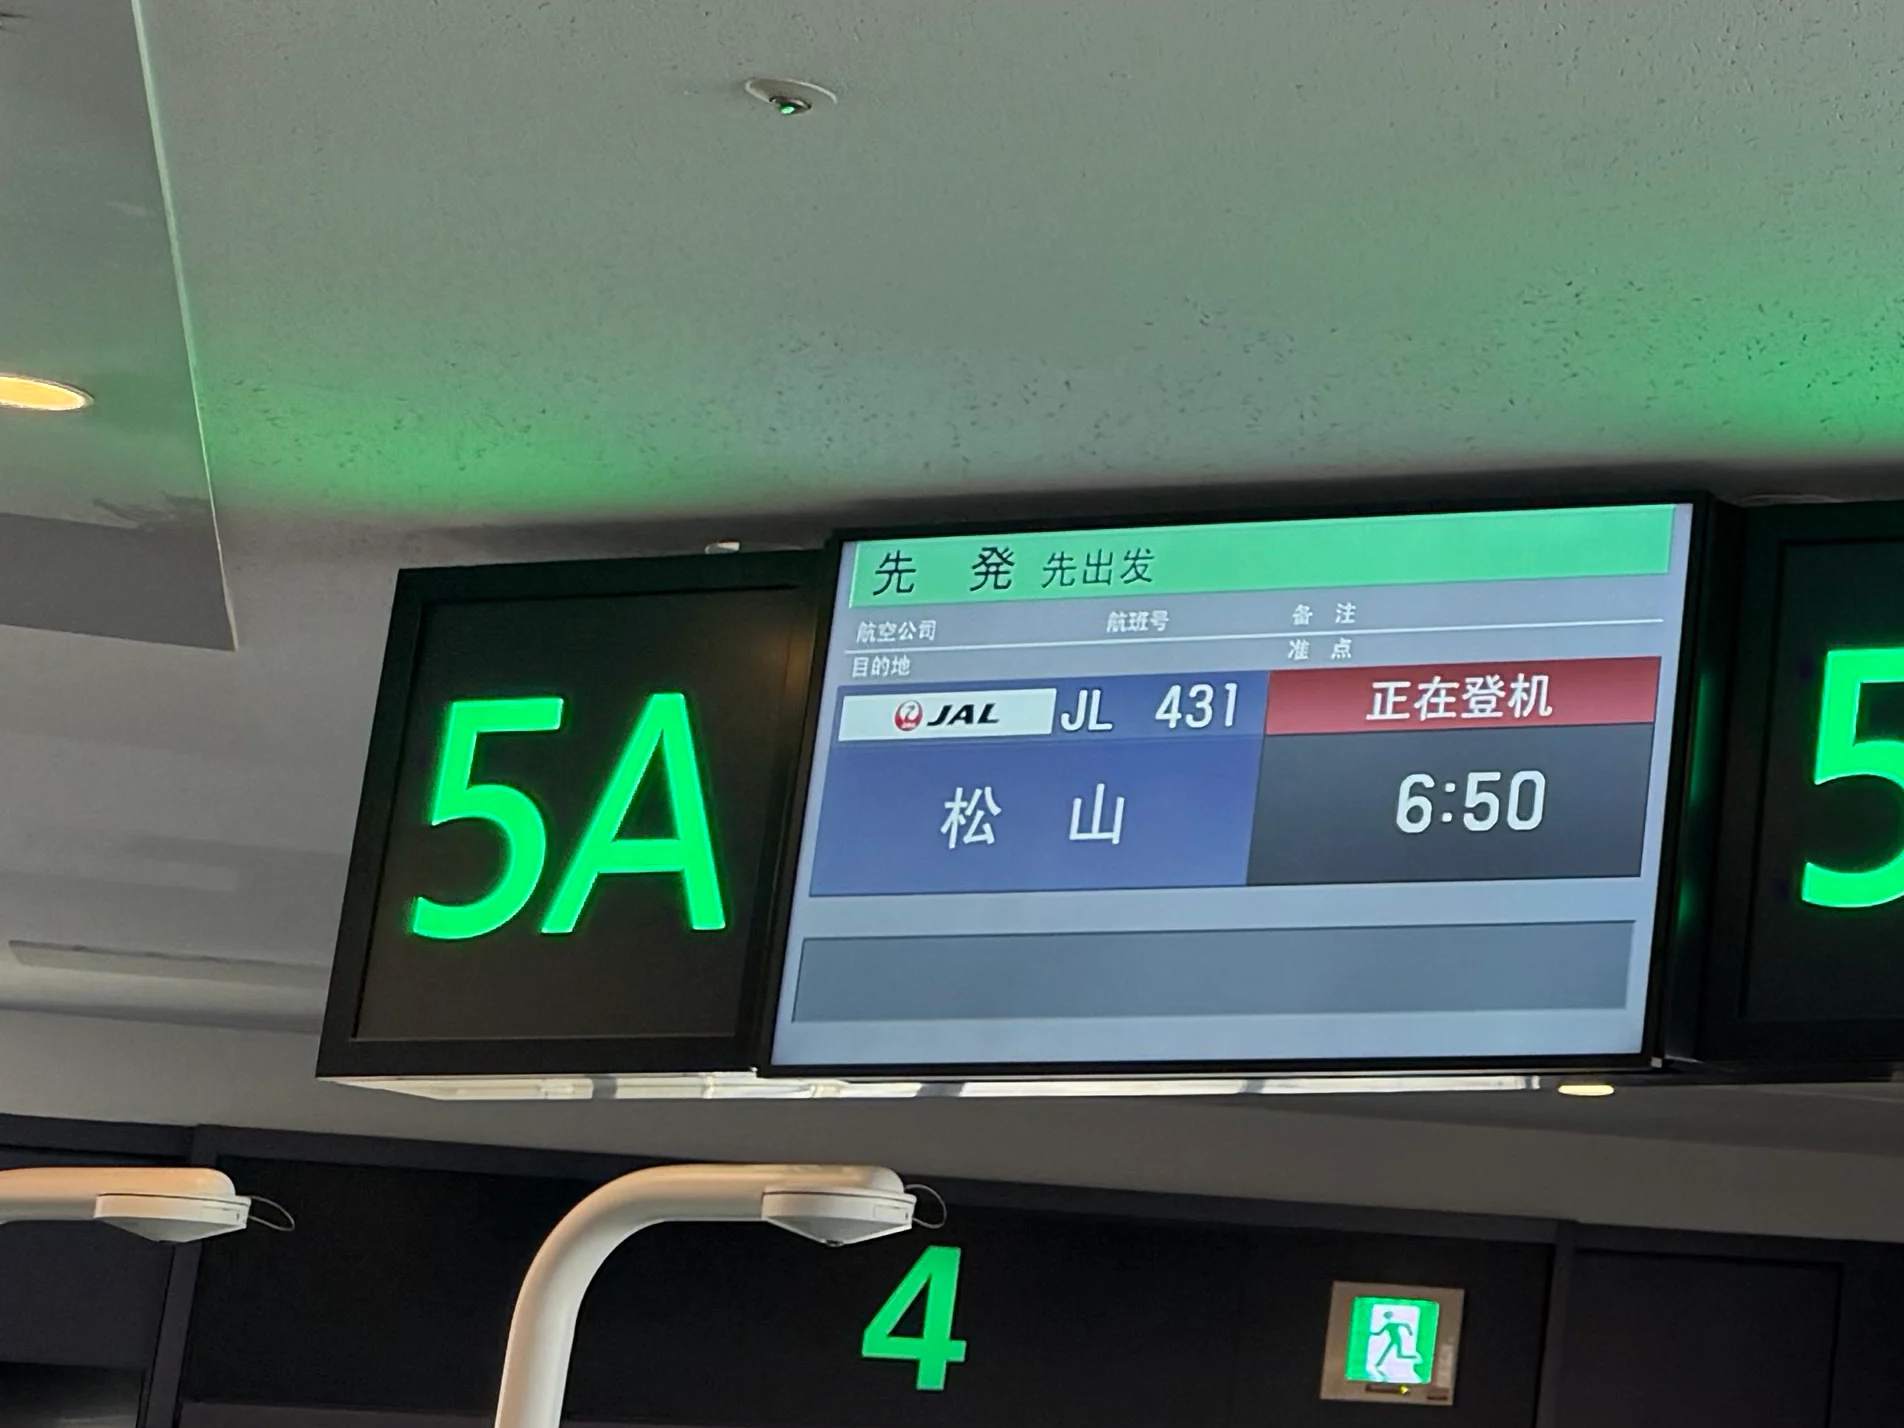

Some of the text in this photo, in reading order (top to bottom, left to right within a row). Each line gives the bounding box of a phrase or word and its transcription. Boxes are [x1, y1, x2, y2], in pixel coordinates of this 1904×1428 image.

[1041, 547, 1155, 589] 先出发
[857, 620, 936, 643] 航空公司
[1107, 610, 1169, 633] 航班号
[851, 654, 910, 677] 目的地
[927, 682, 1237, 730] JAL JL 431
[1366, 673, 1552, 721] 正在登机
[410, 691, 727, 939] 5A
[1394, 769, 1547, 835] 6:50
[861, 1245, 966, 1391] 4
